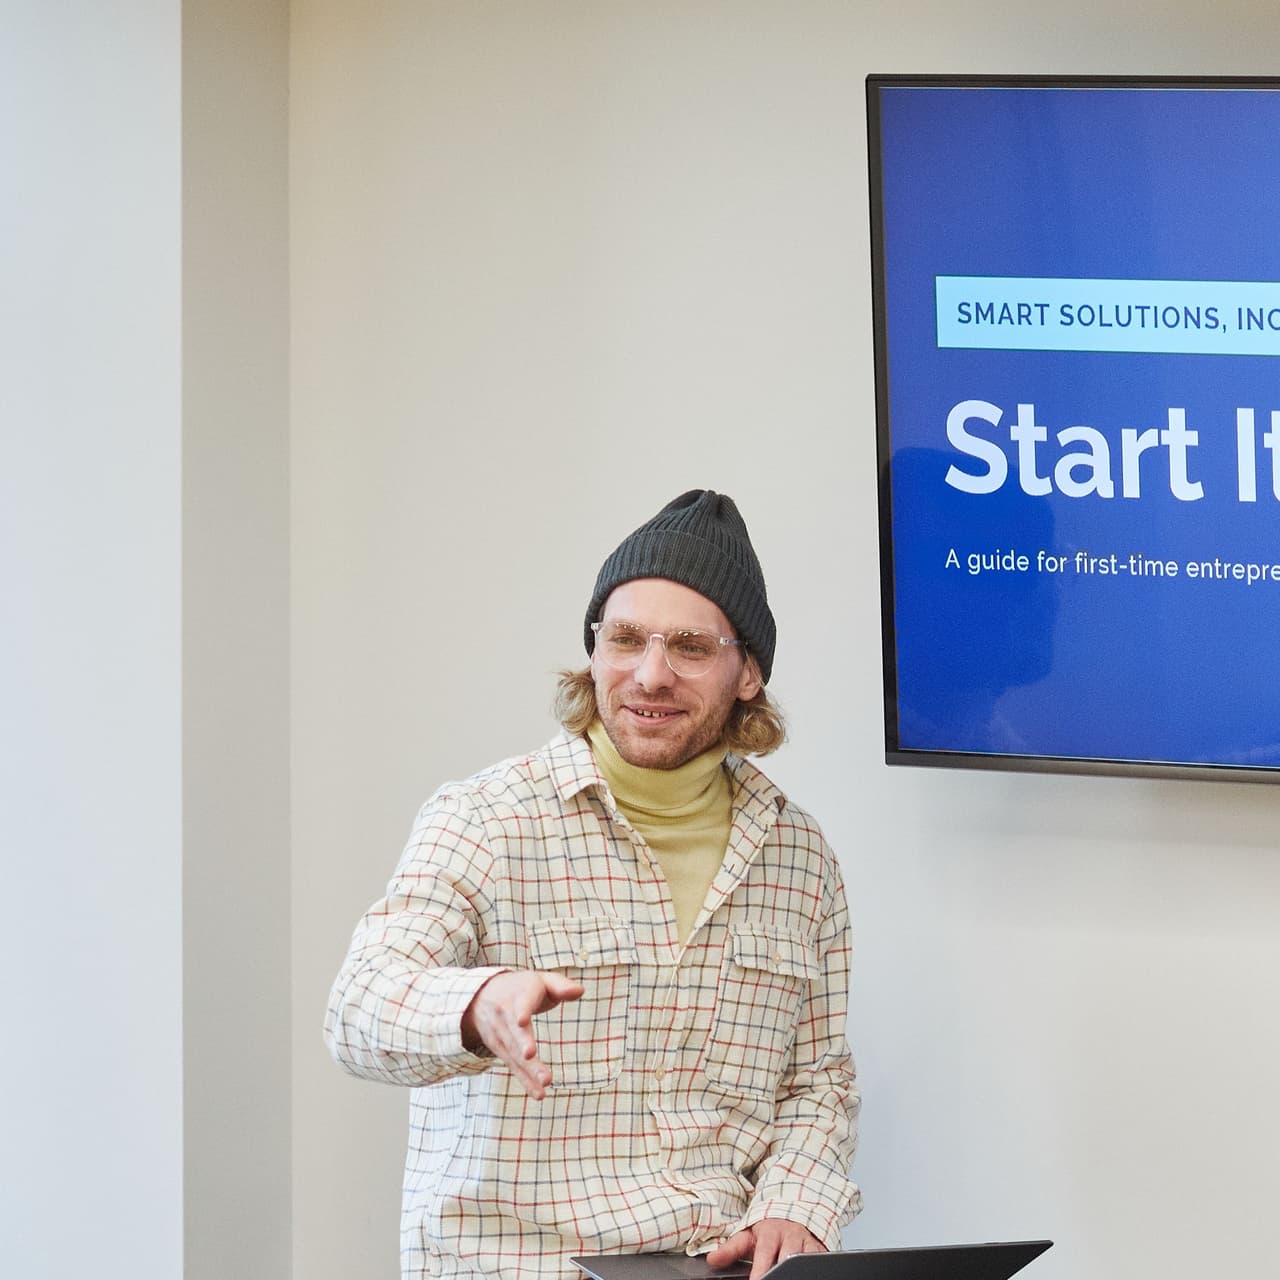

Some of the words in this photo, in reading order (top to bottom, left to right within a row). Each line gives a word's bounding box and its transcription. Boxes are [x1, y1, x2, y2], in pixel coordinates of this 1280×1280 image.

[957, 301, 1051, 327] SMART
[1059, 303, 1227, 334] SOLUTIONS,
[944, 399, 1205, 502] Start
[945, 548, 961, 569] A
[967, 549, 1030, 576] guide
[1037, 550, 1068, 573] for
[1074, 551, 1179, 578] first-time
